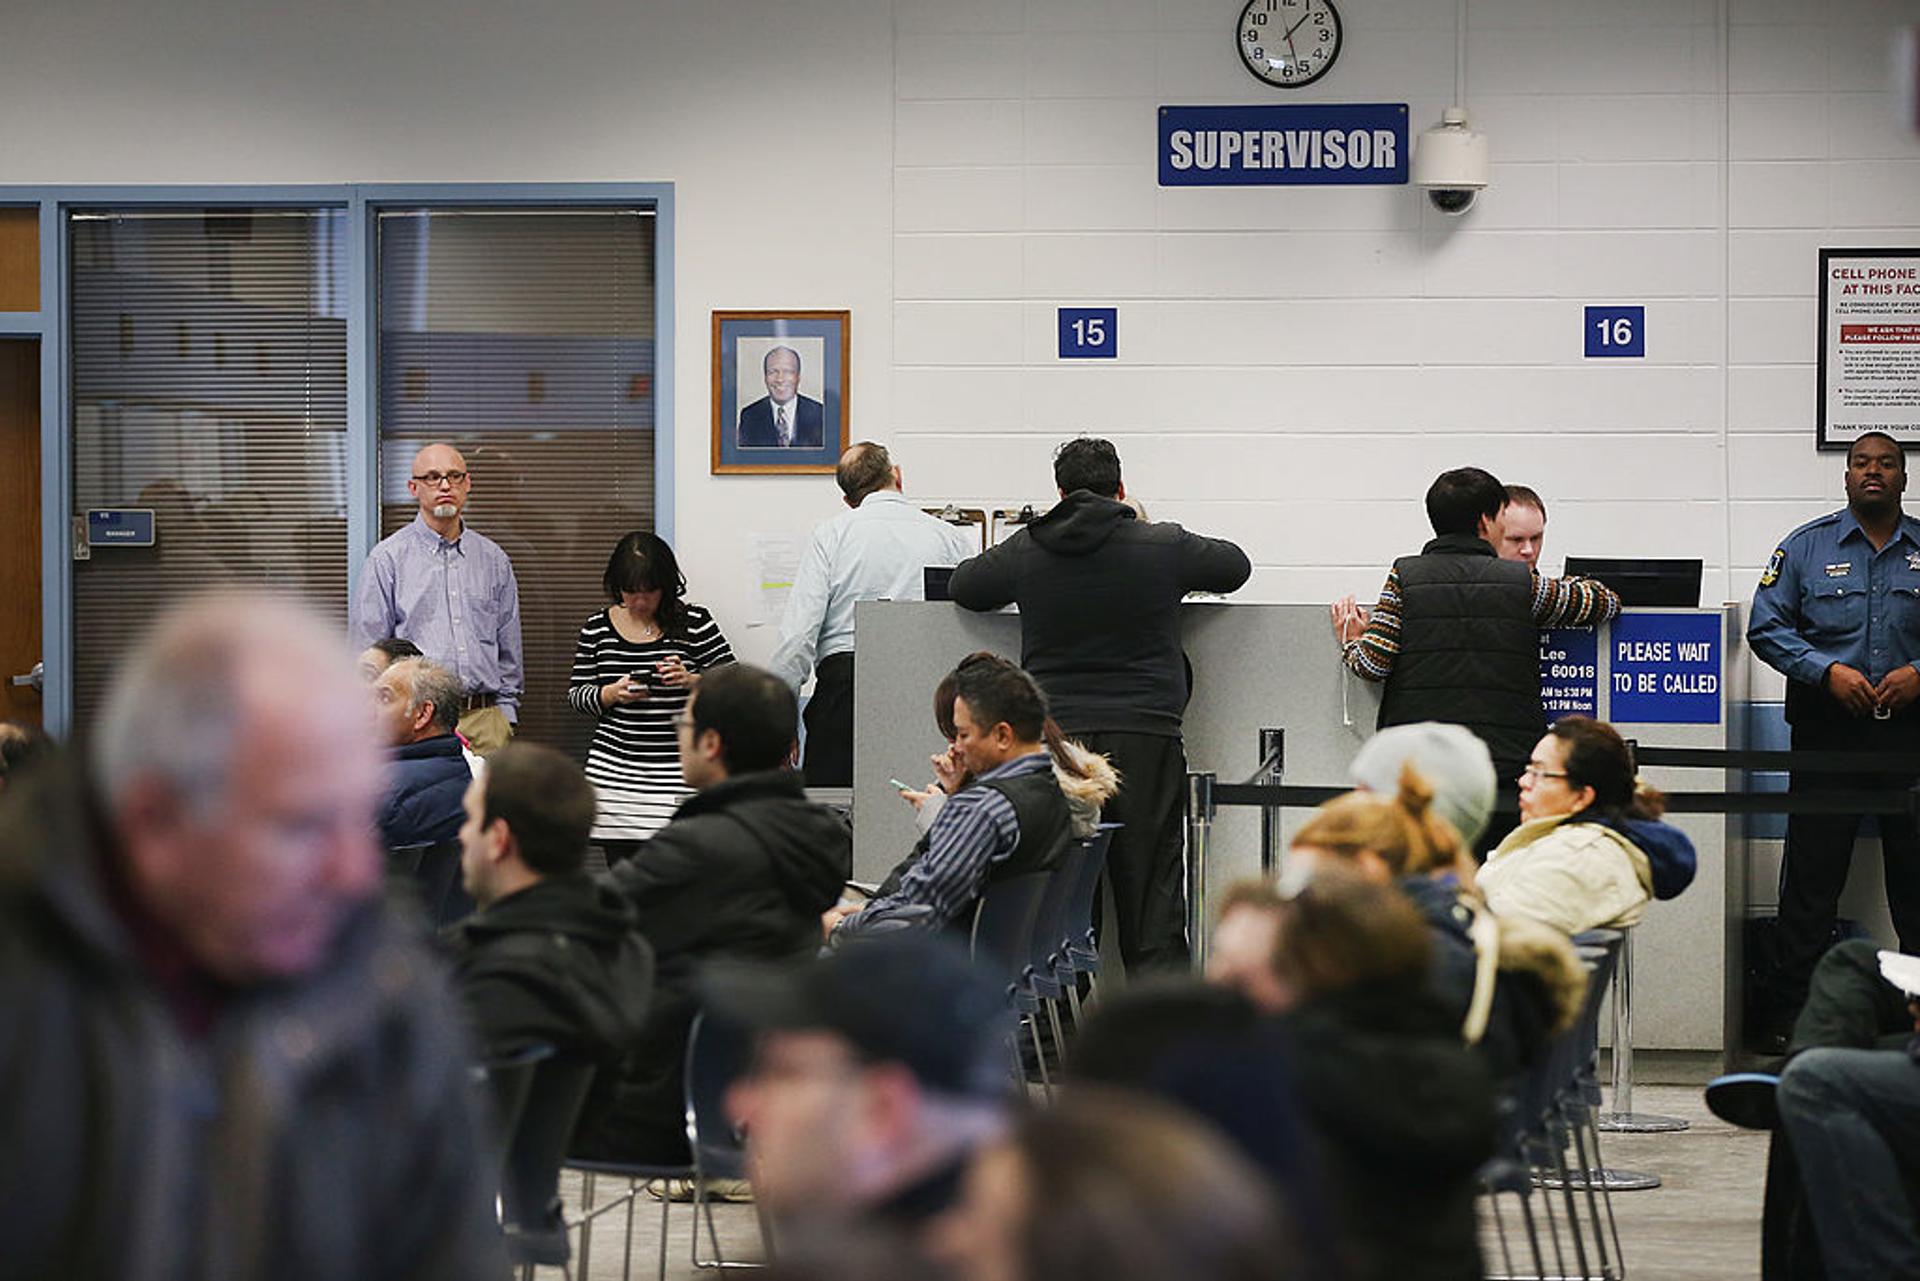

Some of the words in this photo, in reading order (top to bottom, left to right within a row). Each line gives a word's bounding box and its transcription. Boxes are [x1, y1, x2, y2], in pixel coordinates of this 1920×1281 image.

[1252, 13, 1268, 25] 10
[1314, 12, 1324, 25] 2
[1248, 29, 1258, 42] 9
[1319, 29, 1330, 42] 3
[1253, 47, 1264, 59] 8
[1312, 47, 1323, 59] 4
[1282, 64, 1293, 77] 6
[1299, 60, 1309, 72] 5
[1170, 130, 1396, 170] SUPERVISOR
[1832, 268, 1865, 280] CELL
[1868, 268, 1916, 280] PHONE
[1843, 284, 1859, 295] AT
[1862, 284, 1892, 295] THIS
[1072, 319, 1105, 346] 15
[1597, 318, 1632, 345] 16
[1540, 647, 1566, 660] Lee
[1618, 643, 1672, 662] PLEASE
[1677, 643, 1711, 662] WAIT
[1551, 665, 1595, 678] 60018
[1613, 674, 1632, 694] TO
[1638, 674, 1657, 694] BE
[1663, 674, 1717, 694] CALLED
